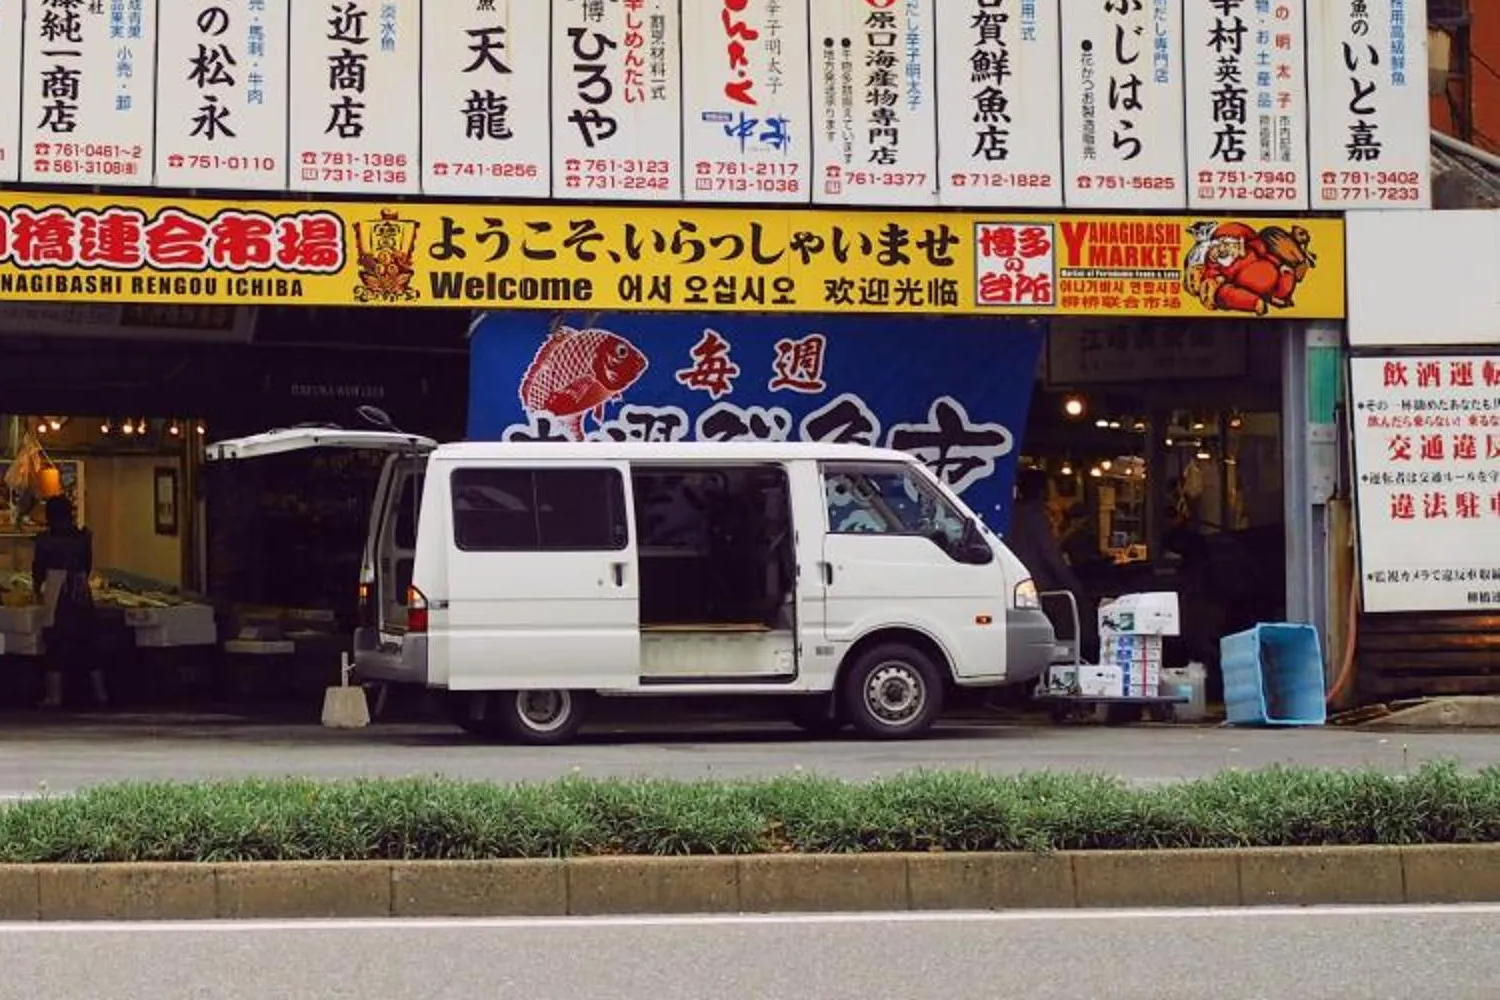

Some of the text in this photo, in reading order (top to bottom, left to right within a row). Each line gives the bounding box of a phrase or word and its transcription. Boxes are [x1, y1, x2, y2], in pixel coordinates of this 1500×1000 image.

[461, 26, 513, 141] 天龍
[567, 27, 618, 148] ひろや
[865, 11, 900, 165] 原口海産物専門店
[1342, 41, 1382, 161] いと嘉
[188, 156, 275, 171] 751-0110
[584, 159, 669, 172] 761-3123
[584, 176, 669, 190] 731-2242
[845, 172, 926, 186] 761-3377
[970, 173, 1052, 187] 712-1822
[1216, 172, 1297, 184] 751-7940
[1217, 187, 1297, 199] 712-0270
[429, 216, 959, 267] ようこそ、いらっしゃいませ
[979, 226, 1051, 258] 博多
[1004, 257, 1025, 273] の
[1089, 246, 1180, 267] MARKET
[131, 276, 217, 297] RENGOU
[226, 277, 303, 298] ICHIBA
[429, 271, 593, 301] Welcome
[618, 274, 796, 305] 어서 오십시오
[825, 277, 958, 307] 欢迎光临
[677, 330, 826, 397] 毎週
